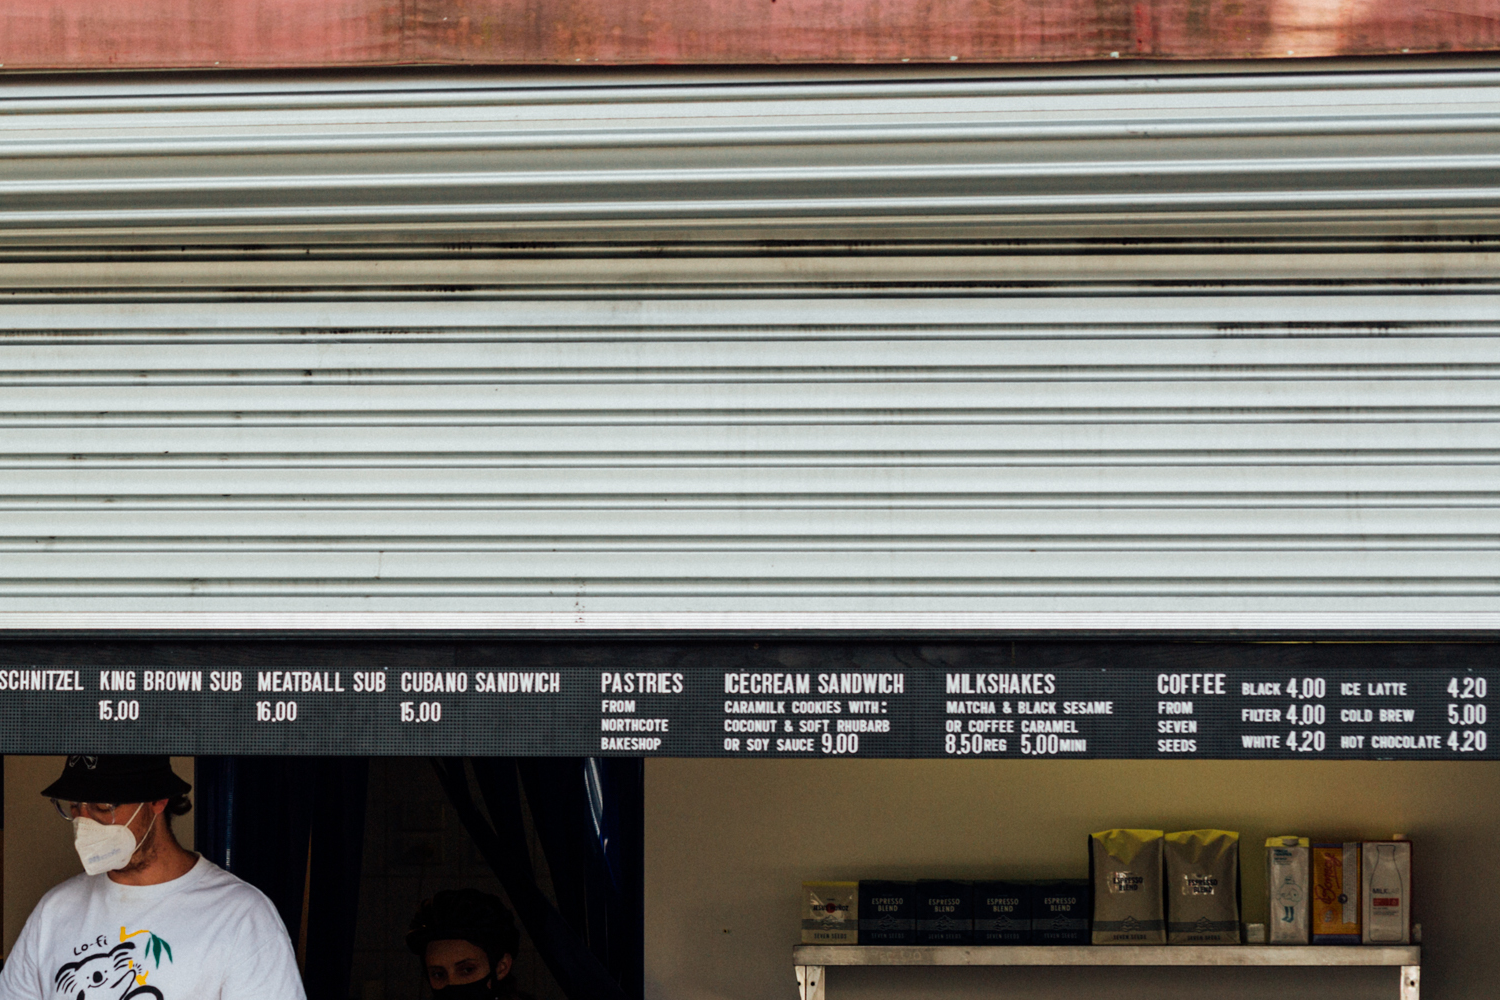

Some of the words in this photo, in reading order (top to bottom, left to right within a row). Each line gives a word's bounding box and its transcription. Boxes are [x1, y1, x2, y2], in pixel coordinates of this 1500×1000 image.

[100, 670, 135, 691] KING
[144, 670, 201, 691] BROWN
[210, 670, 242, 692] SUB
[257, 671, 344, 693] MEATBALL
[353, 671, 386, 693] SUB
[401, 671, 467, 693] CUBANO
[475, 671, 560, 693] SANDWICH
[601, 672, 683, 693] PASTRIES
[724, 672, 810, 694] ICECREAM
[818, 672, 904, 694] SANDWICH
[946, 673, 1055, 694] MILKSHAKES
[1157, 673, 1226, 695] COFFEE
[1242, 682, 1281, 696] BLACK
[1286, 677, 1326, 699] 4.00
[1341, 682, 1361, 696] ICE
[1368, 682, 1407, 696] LATTE
[1447, 677, 1487, 699] 4.20
[99, 700, 140, 721] 15.00
[256, 700, 298, 722] 16.00
[400, 701, 441, 722] 15.00
[601, 700, 636, 713] FROM
[724, 701, 785, 714] CARAMILK
[792, 701, 841, 714] COOKIES
[849, 701, 888, 714] WITH:
[946, 701, 996, 714] MATCHA
[1002, 701, 1012, 714] &
[1018, 701, 1056, 714] BLACK
[1063, 701, 1113, 714] SESAME
[1158, 701, 1193, 714] FROM
[1242, 708, 1281, 722] FILTER
[1286, 704, 1326, 726] 4.00
[1341, 708, 1373, 723] COLD
[1379, 708, 1414, 722] BREW
[1448, 704, 1487, 725] 5.00
[601, 719, 669, 732] NORTHCOTE
[724, 720, 777, 733] COCONUT
[784, 720, 793, 733] &
[799, 720, 829, 733] SOFT
[837, 720, 890, 733] RHUBARB
[946, 720, 962, 733] OR
[968, 720, 1015, 733] COFFEE
[1021, 720, 1079, 733] CARAMEL
[1158, 720, 1197, 733] SEVEN
[601, 737, 661, 750] BAKESHOP
[724, 738, 740, 751] OR
[747, 738, 769, 751] SOY
[777, 738, 814, 751] SAUCE
[822, 733, 859, 755] 9.00
[1158, 738, 1197, 752] SEEDS
[1242, 735, 1280, 749] WHITE
[1286, 730, 1326, 752] 4.20
[1341, 735, 1364, 749] HOT
[1371, 735, 1441, 749] CHOCOLATE
[1447, 730, 1487, 752] 4.20
[928, 898, 961, 906] ESPRESSO
[986, 898, 1019, 906] ESPRESSO
[1044, 897, 1077, 905] ESPRESSO
